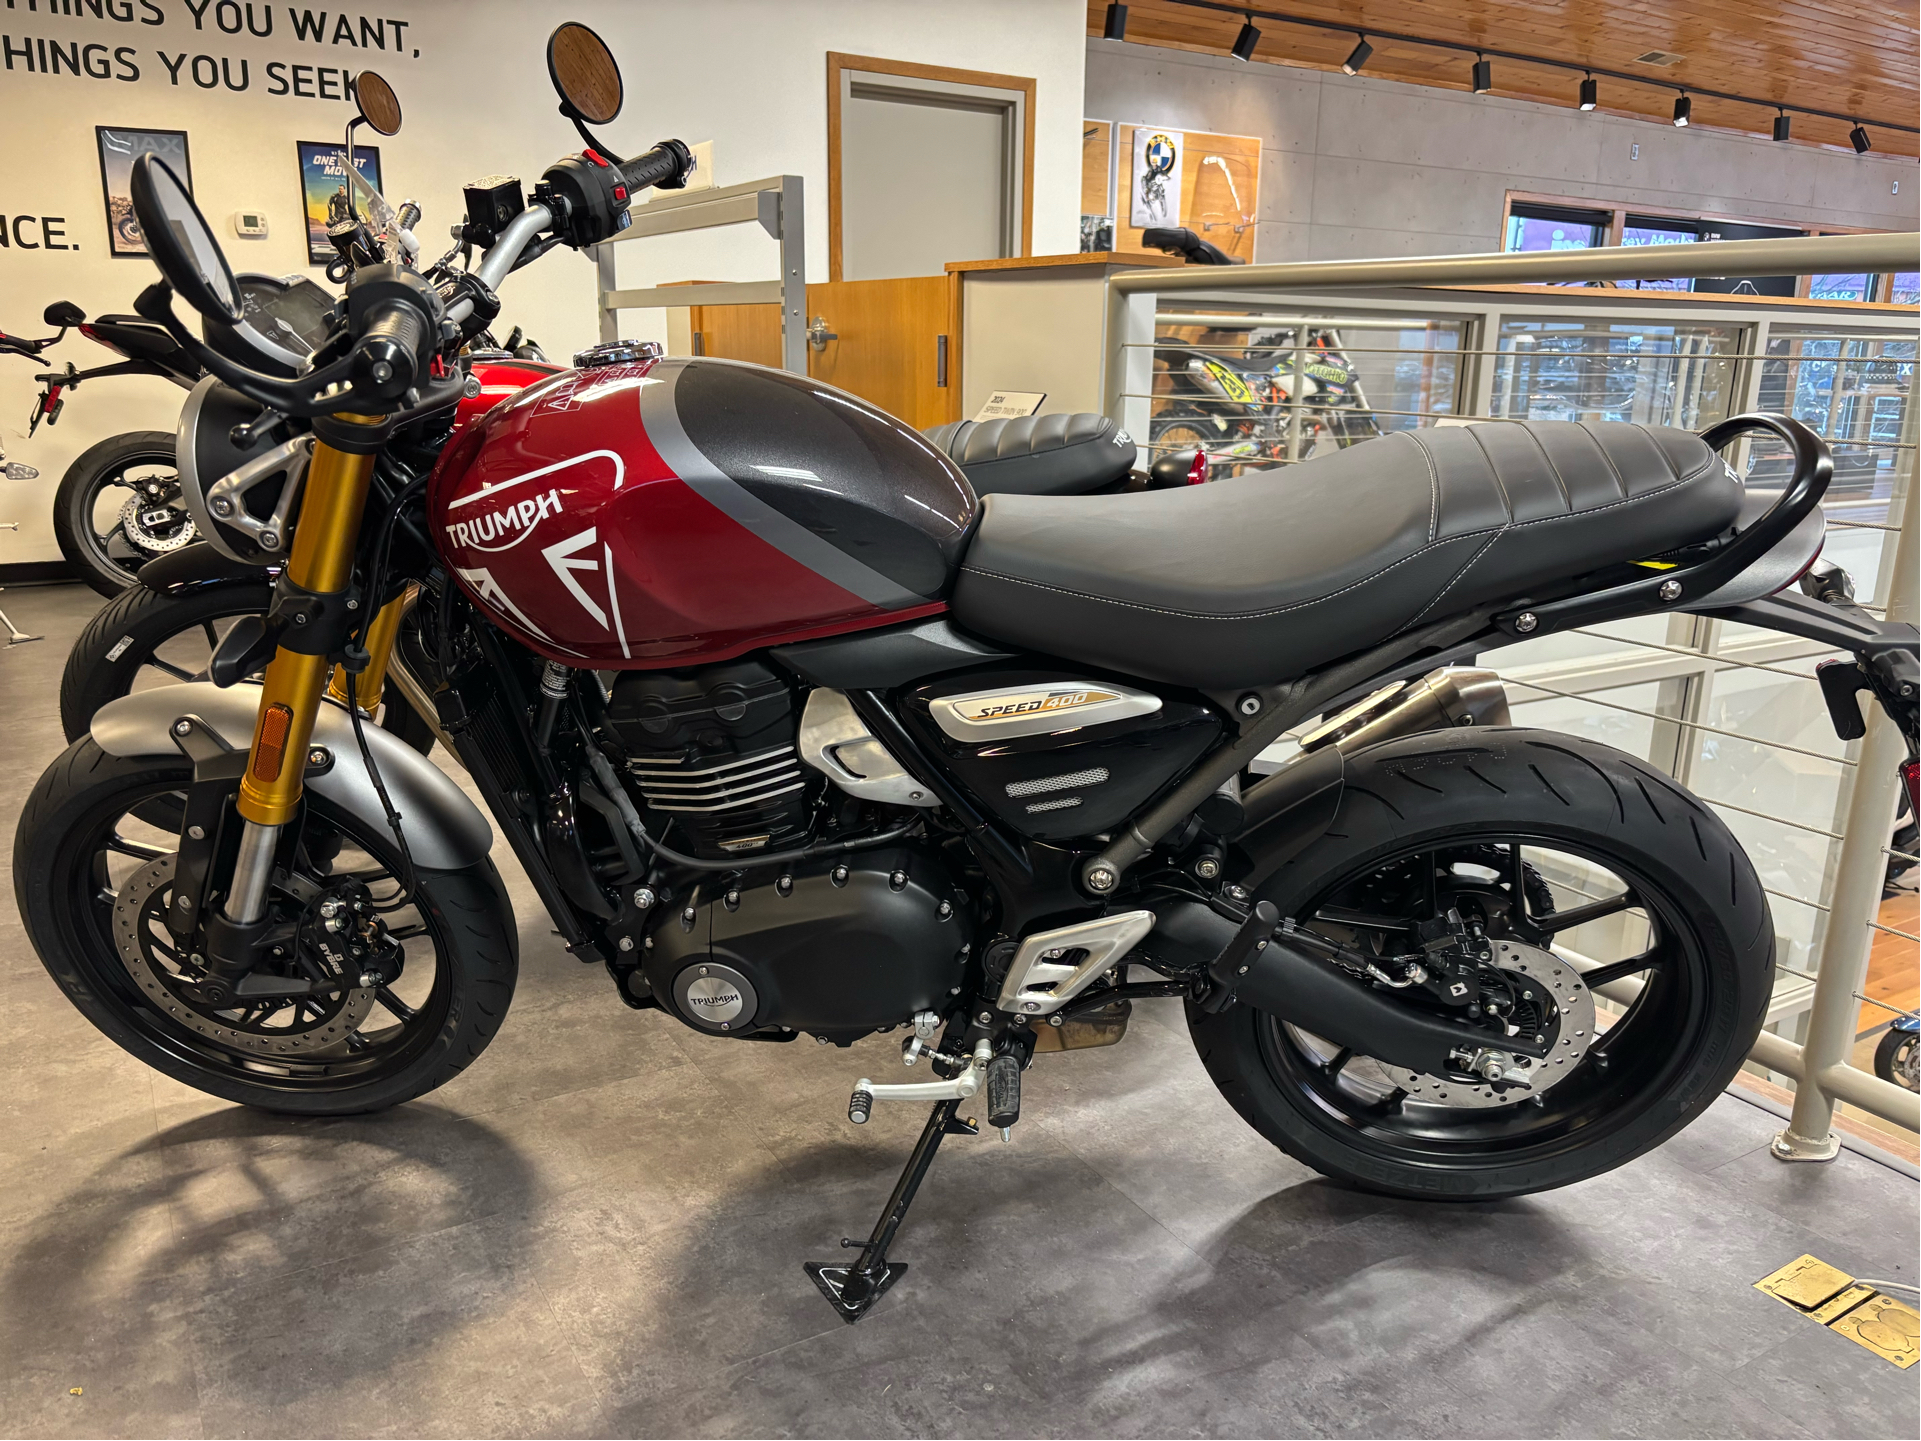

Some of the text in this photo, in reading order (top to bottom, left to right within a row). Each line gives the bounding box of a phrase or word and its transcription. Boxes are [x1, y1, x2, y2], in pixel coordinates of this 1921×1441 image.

[6, 0, 420, 58] NGS YOU WANT,
[156, 50, 250, 92] YOU
[313, 155, 367, 168] ONE ST
[446, 488, 563, 552] TRIUMPH
[977, 692, 1088, 718] SPEED 400
[318, 942, 344, 975] BYBRE
[690, 993, 739, 1007] TRIUMPH
